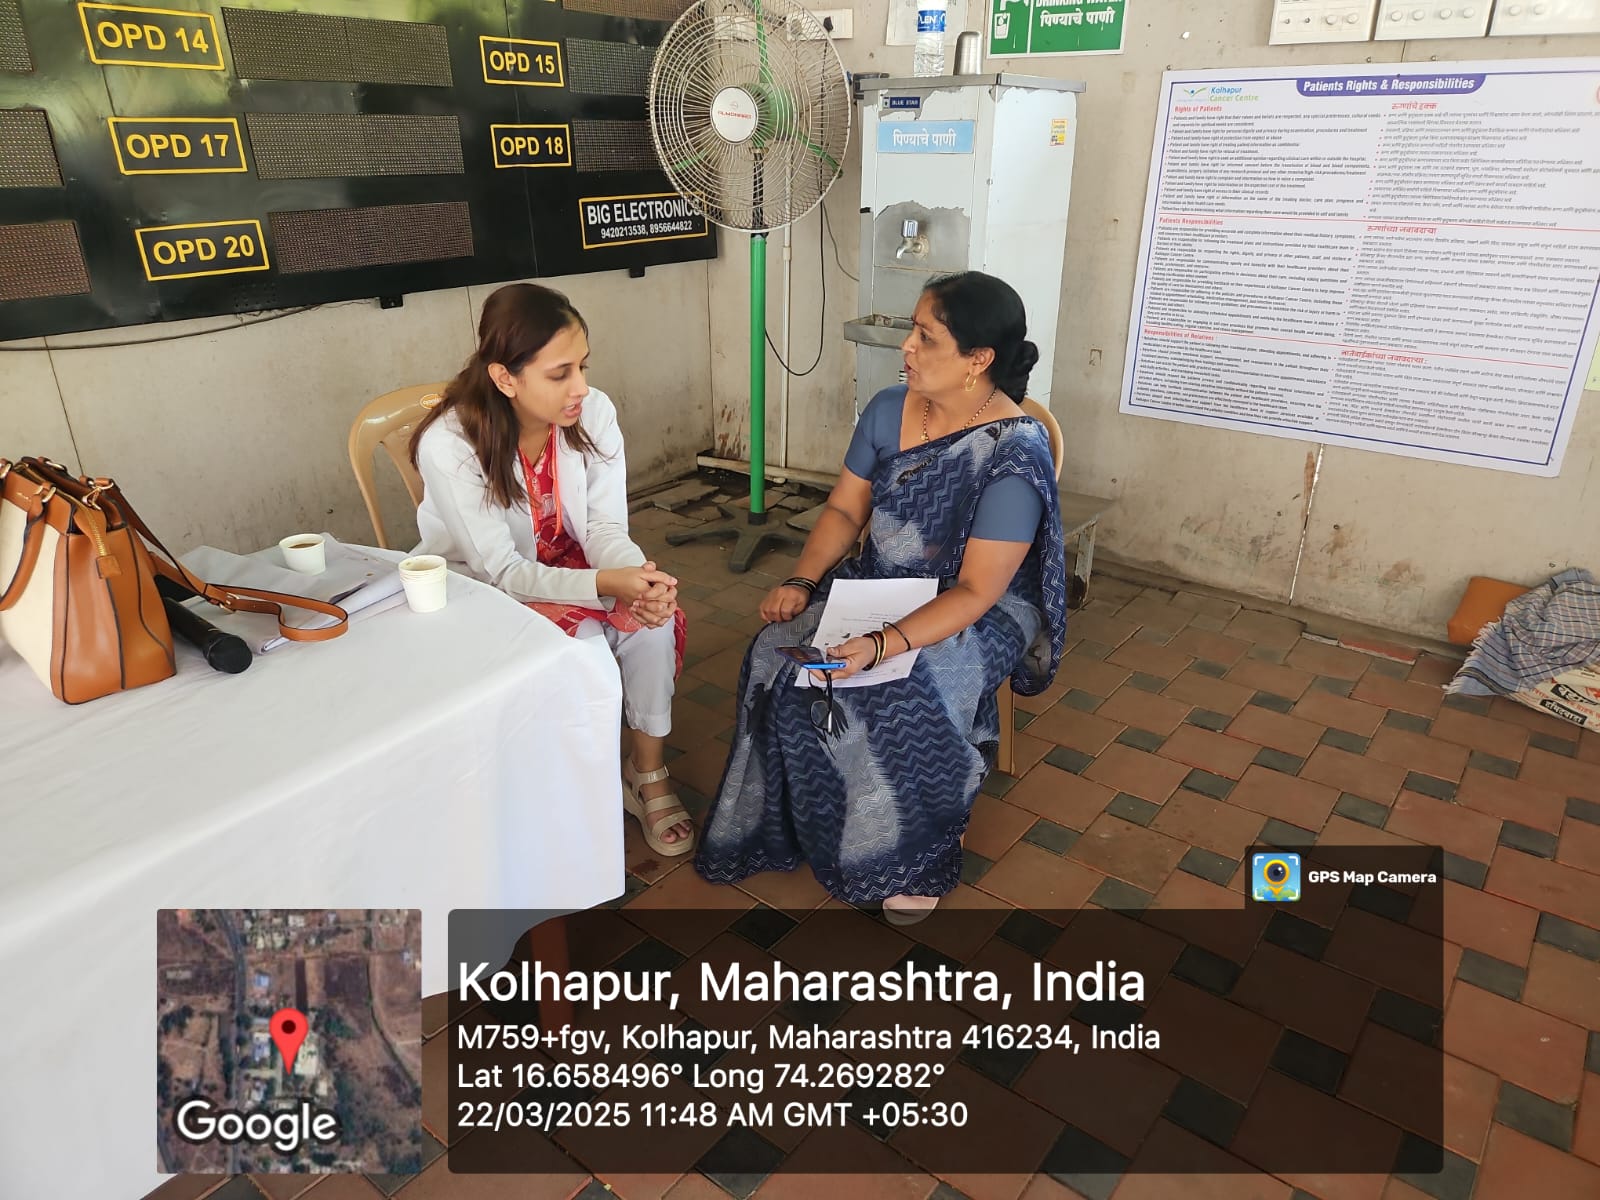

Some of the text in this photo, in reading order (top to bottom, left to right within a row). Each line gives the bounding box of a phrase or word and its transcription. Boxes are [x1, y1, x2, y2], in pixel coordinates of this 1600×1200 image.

[1040, 6, 1115, 27] पिण्याचे पाणी
[97, 20, 209, 54] OPD 14
[489, 51, 556, 75] OPD 15
[1210, 86, 1242, 95] Kolhapur
[1303, 78, 1475, 93] Patients Rights & Responsibilities
[1235, 94, 1259, 102] Centre
[126, 133, 229, 160] OPD 17
[500, 137, 564, 156] OPD 18
[893, 128, 957, 147] पिण्याचे पाणी
[587, 199, 701, 225] BIG ELECTRONICS
[601, 220, 693, 239] 9420213538, 8956644822
[153, 235, 255, 265] OPD 20
